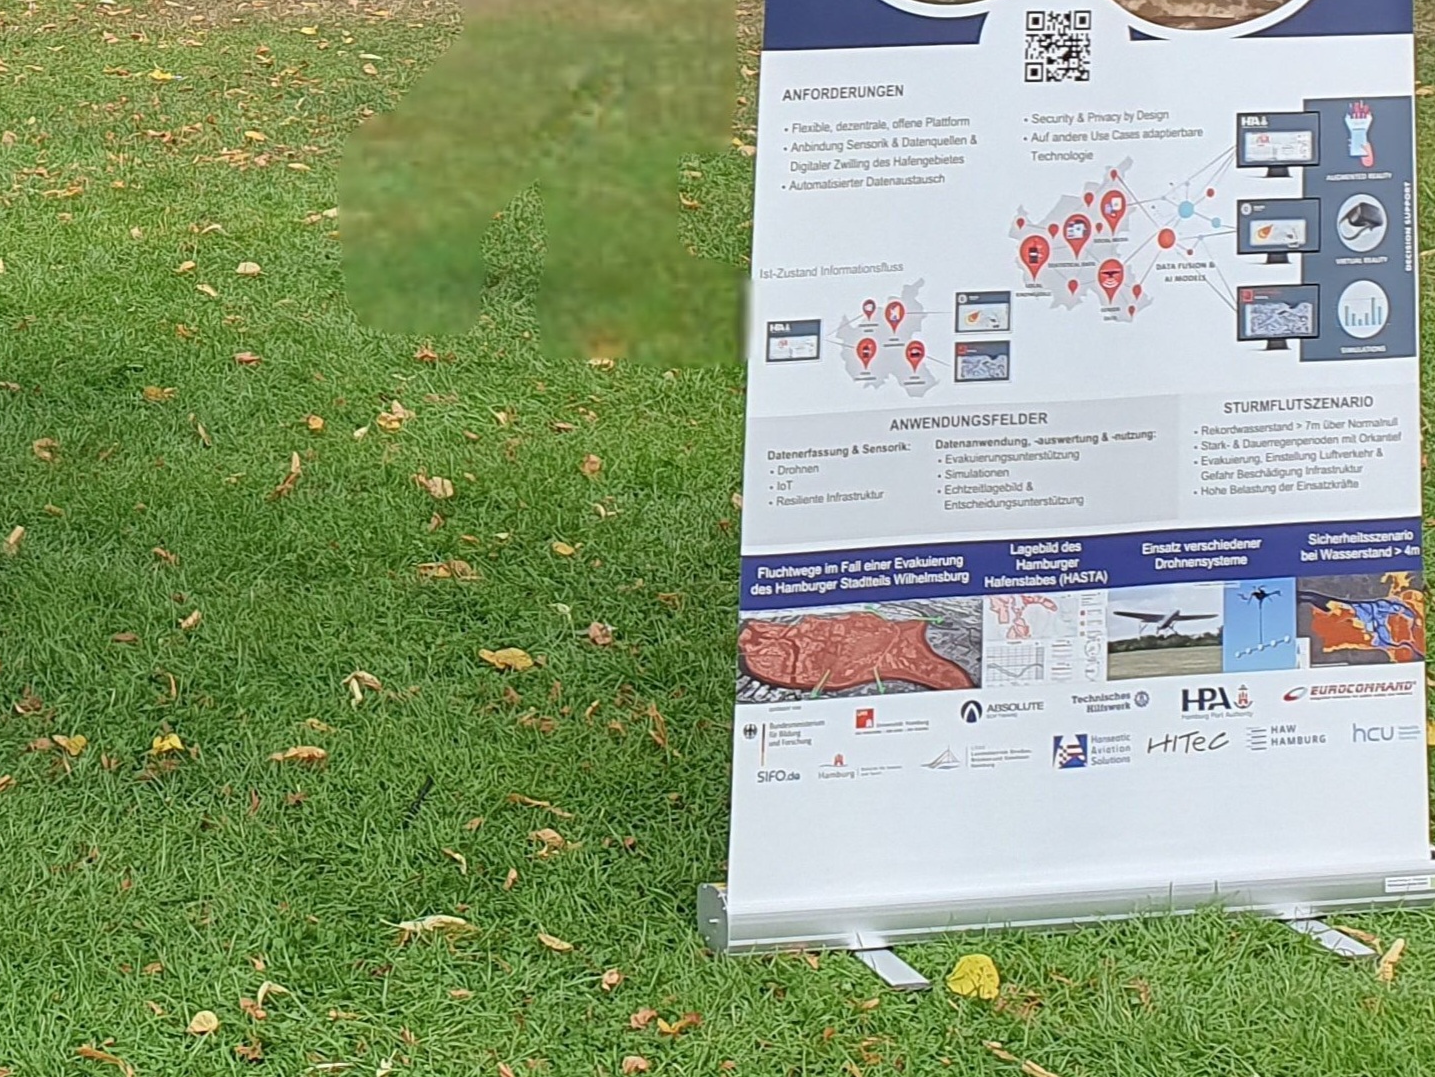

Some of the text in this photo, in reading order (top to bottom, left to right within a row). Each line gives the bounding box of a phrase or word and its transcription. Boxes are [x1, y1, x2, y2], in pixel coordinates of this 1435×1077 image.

[782, 84, 904, 102] ANFORDERUNGEN
[792, 115, 970, 135] Flexible, dezentrale, offene Plattform
[1031, 108, 1169, 127] Security & Privacy by Design
[1031, 126, 1204, 143] Auf andere Use Cases adaptierbare
[791, 134, 978, 155] Anbindung Sensorik & Datenquellen &
[790, 154, 965, 174] Digitaler Zwilling des Hafengebietes
[1031, 149, 1094, 164] Technologie
[789, 173, 945, 191] Automatisierter Datenaustausch
[1404, 182, 1412, 227] SUPPORT
[760, 262, 904, 280] Ist-Zustand Informationsfluss
[1156, 263, 1175, 271] DATA
[1178, 262, 1207, 270] FUSION
[1174, 274, 1207, 283] MODELS
[1224, 395, 1374, 414] STURMFLUTSZENARIO
[890, 413, 1048, 432] ANWENDUNGSFELDER
[1201, 421, 1294, 437] Rekordwasserstand
[1305, 420, 1320, 431] 7m
[1323, 418, 1345, 431] über
[1348, 417, 1399, 429] Normalnull
[935, 430, 1157, 453] Datenanwendung, -auswertung & -nutzung:
[1201, 432, 1402, 451] Stark- & Dauerregenperioden mit Orkantief
[767, 441, 911, 462] Datenerfassung & Sensorik:
[945, 450, 1080, 466] Evakuierungsunterstützung
[1201, 447, 1383, 468] Evakuierung, Einstellung Luftverkehr &
[777, 464, 819, 476] Drohnen
[945, 468, 1010, 479] Simulationen
[1201, 463, 1363, 482] Gefahr Beschädigung Infrastruktur
[777, 481, 793, 492] IoT
[944, 481, 1033, 497] Echtzeitlagebild &
[1201, 478, 1359, 497] Hohe Belastung der Einsatzkräfte
[776, 489, 884, 507] Resiliente Infrastruktur
[944, 493, 1084, 512] Entscheidungsunterstützung
[1142, 537, 1262, 556] Einsatz verschiedener
[1308, 529, 1414, 546] Sicherheitsszenario
[1010, 540, 1082, 558] Lagebild des
[1301, 545, 1420, 563] bei Wasserstand > 4m
[758, 555, 964, 581] Fluchtwege im Fall einer Evakuierung
[1016, 557, 1078, 574] Hamburger
[1155, 554, 1248, 571] Drohnensysteme
[750, 570, 970, 596] des Hamburger Stadtteils Wilhelmsburg
[984, 570, 1108, 589] Hafenstabes (HASTA)
[986, 701, 1044, 713] ABSOLUTE
[1072, 692, 1131, 705] Technisches
[1086, 702, 1131, 713] Hilfswerk
[1182, 687, 1232, 713] HPA
[1271, 724, 1297, 734] HAW
[1353, 723, 1395, 743] hcu
[1091, 733, 1131, 744] Hanseatic
[1271, 734, 1326, 745] HAMBURG
[1091, 744, 1131, 754] Aviation
[1091, 755, 1131, 766] Solutions
